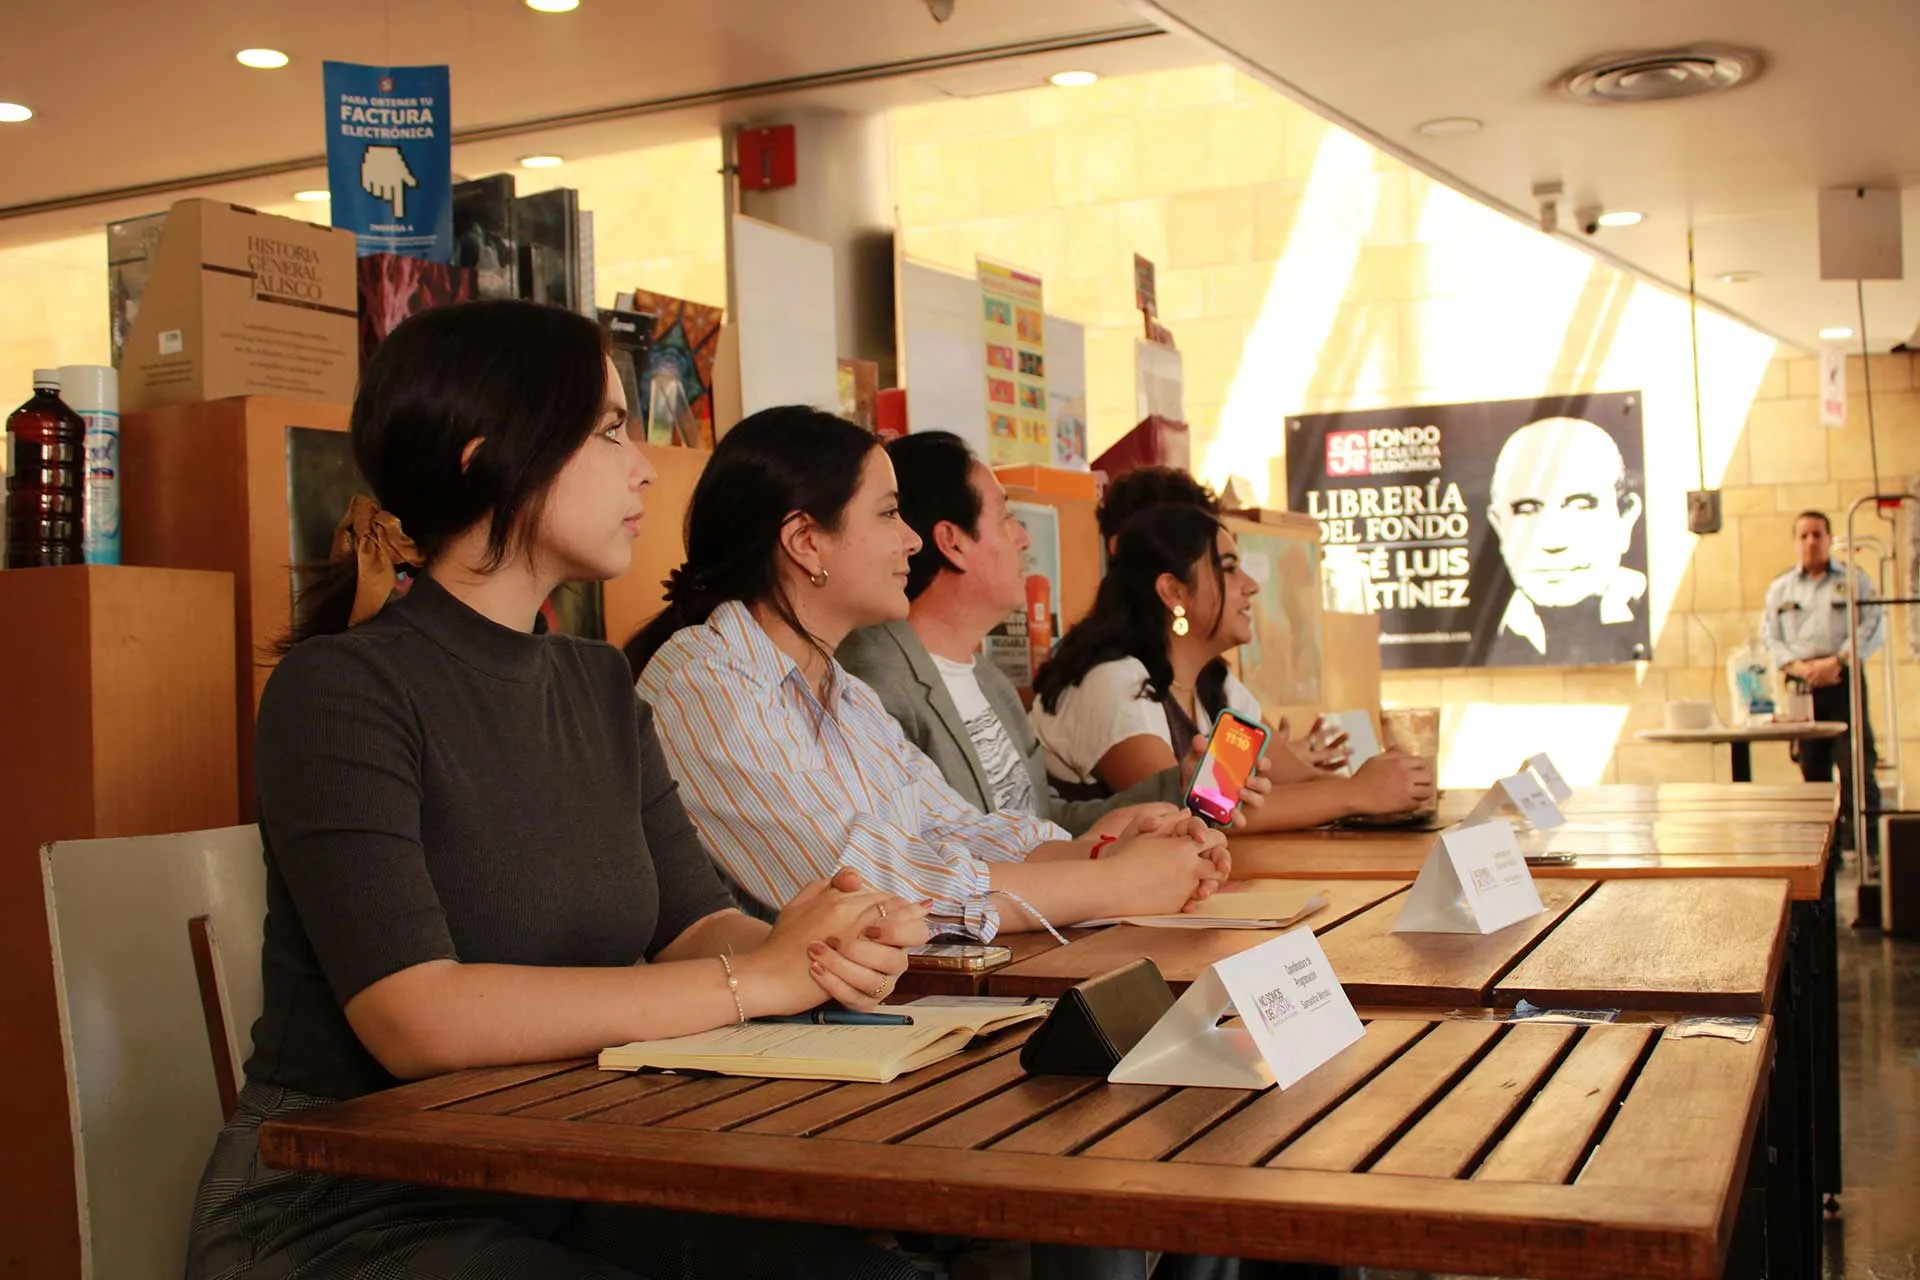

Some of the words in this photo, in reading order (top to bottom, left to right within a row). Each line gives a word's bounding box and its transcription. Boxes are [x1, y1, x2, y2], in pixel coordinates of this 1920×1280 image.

[341, 105, 434, 124] FACTURA
[341, 123, 435, 139] ELECTRÓNICA
[247, 236, 320, 264] HISTORIA
[247, 254, 321, 282] GENERAL
[249, 275, 323, 301] JALISCO
[1368, 425, 1441, 448] FONDO
[1307, 477, 1468, 519] LIBRERÍA
[1366, 513, 1469, 542] FONDO
[1396, 547, 1470, 578] LUIS
